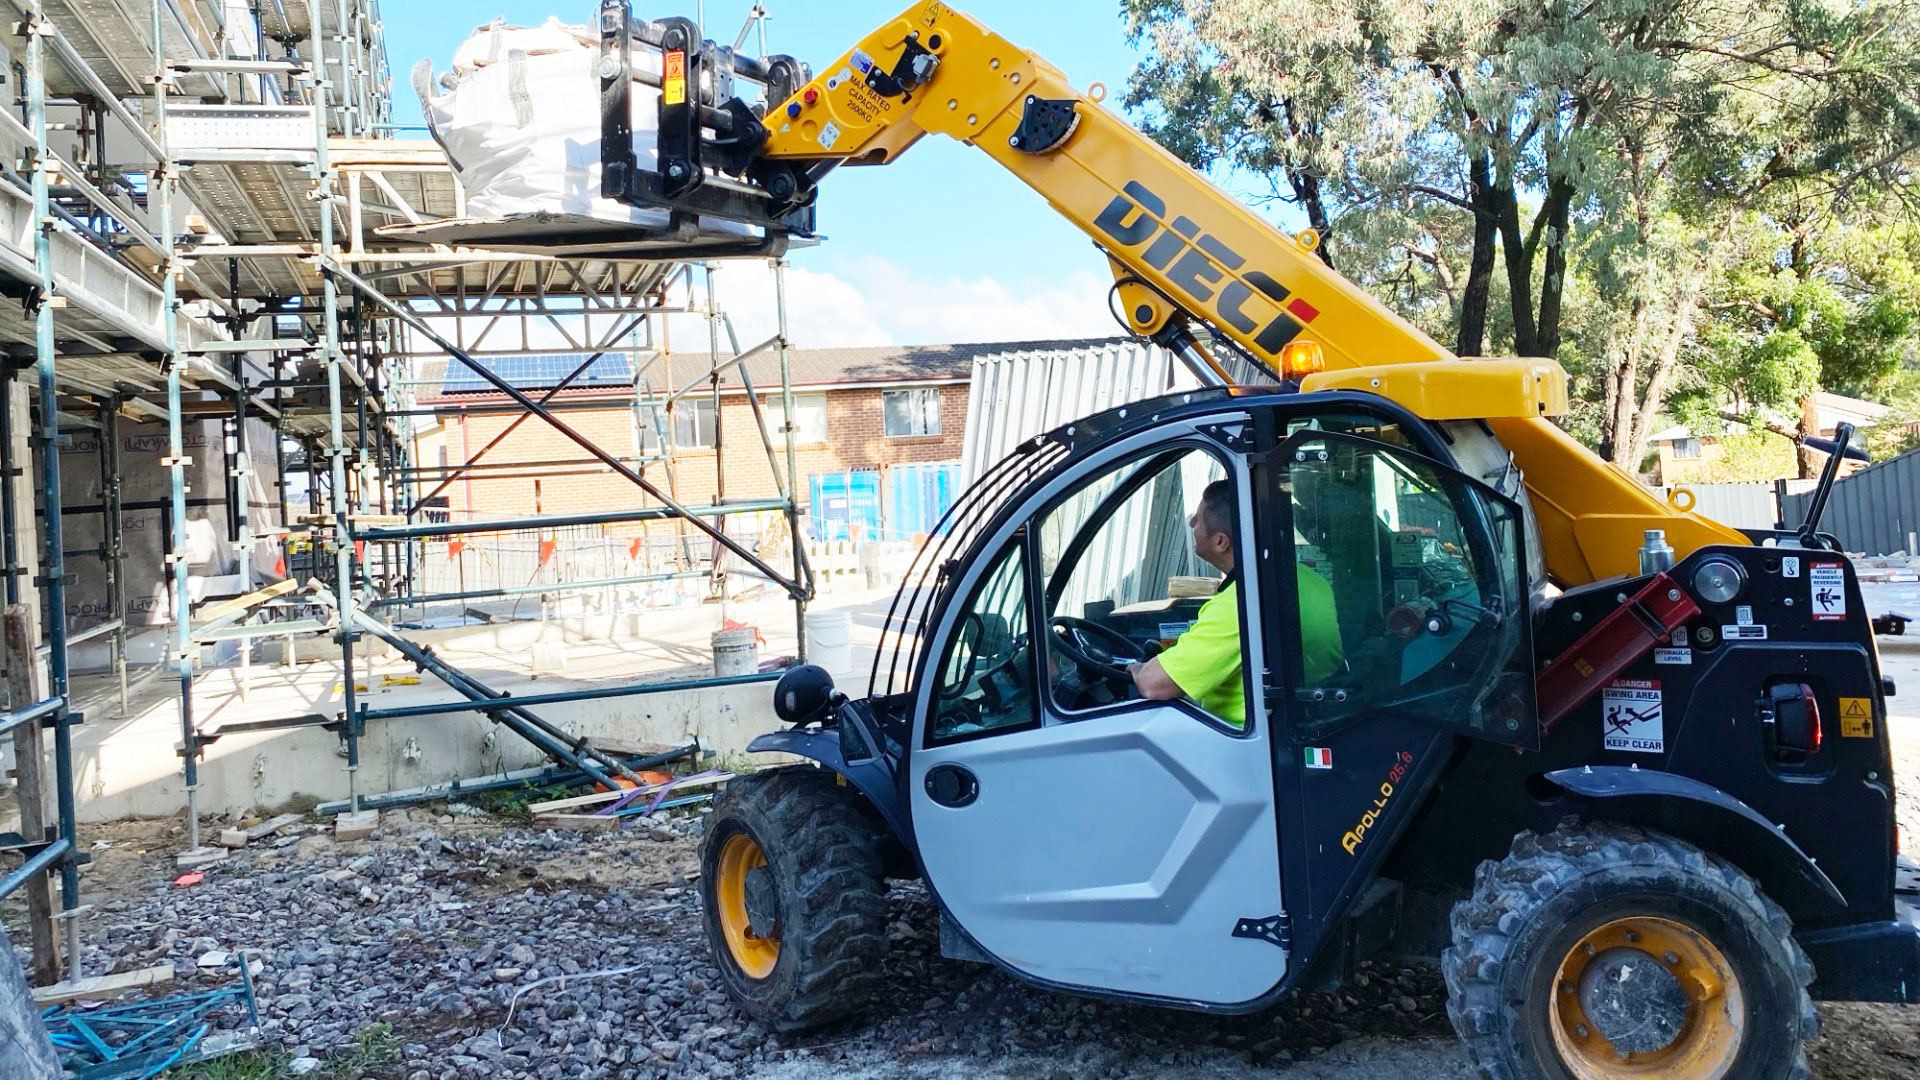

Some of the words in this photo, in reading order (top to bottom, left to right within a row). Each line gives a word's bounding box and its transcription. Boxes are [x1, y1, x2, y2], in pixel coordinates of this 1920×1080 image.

[848, 88, 881, 116] CAPACITY
[867, 89, 891, 112] RATED
[847, 100, 872, 123] 2500KG
[1620, 680, 1652, 689] DANGER
[1605, 690, 1634, 699] SWING
[1636, 691, 1660, 700] AREA
[1606, 738, 1629, 748] KEEP
[1632, 740, 1662, 750] CLEAR
